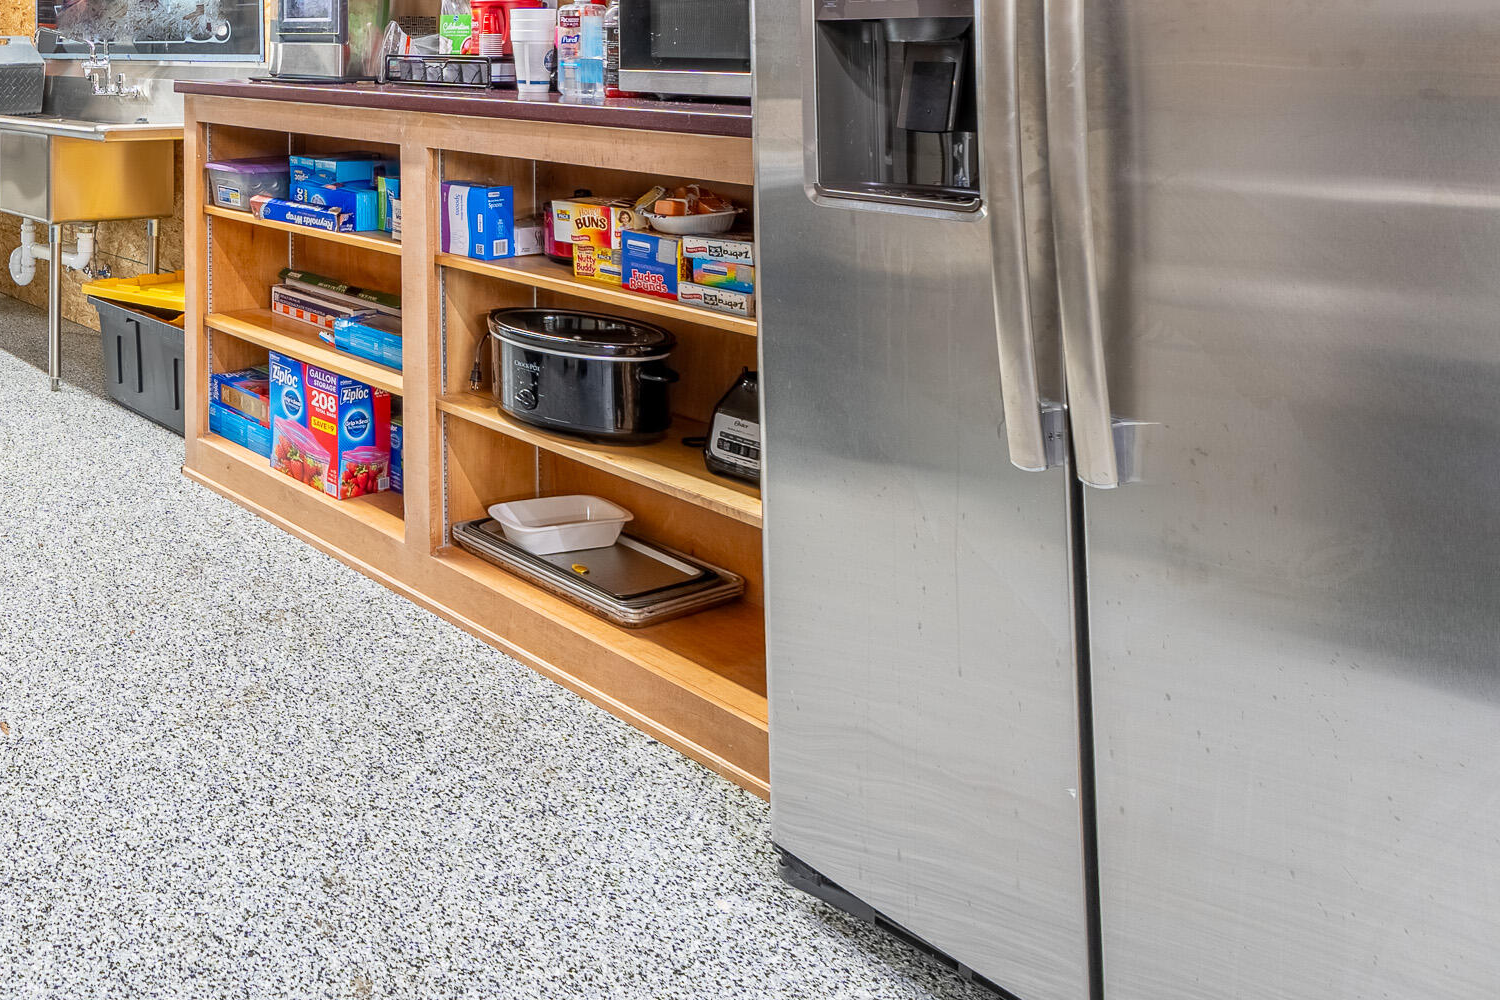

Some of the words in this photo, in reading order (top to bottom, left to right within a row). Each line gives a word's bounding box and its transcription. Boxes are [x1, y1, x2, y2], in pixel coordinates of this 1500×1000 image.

[286, 211, 303, 224] Wrap
[303, 214, 333, 231] Reynolds
[575, 216, 607, 230] BUNS
[577, 254, 596, 265] Nutty
[723, 249, 751, 260] Zebra
[576, 263, 596, 274] Buddy
[631, 268, 664, 283] Fudge
[629, 277, 668, 293] Rounds
[718, 298, 745, 310] Zebra
[272, 364, 298, 388] Ziploc
[309, 368, 337, 386] GALLON
[313, 379, 337, 393] STORAGE
[311, 390, 336, 413] 208
[342, 388, 369, 404] Ziploc
[312, 418, 327, 430] SAVE
